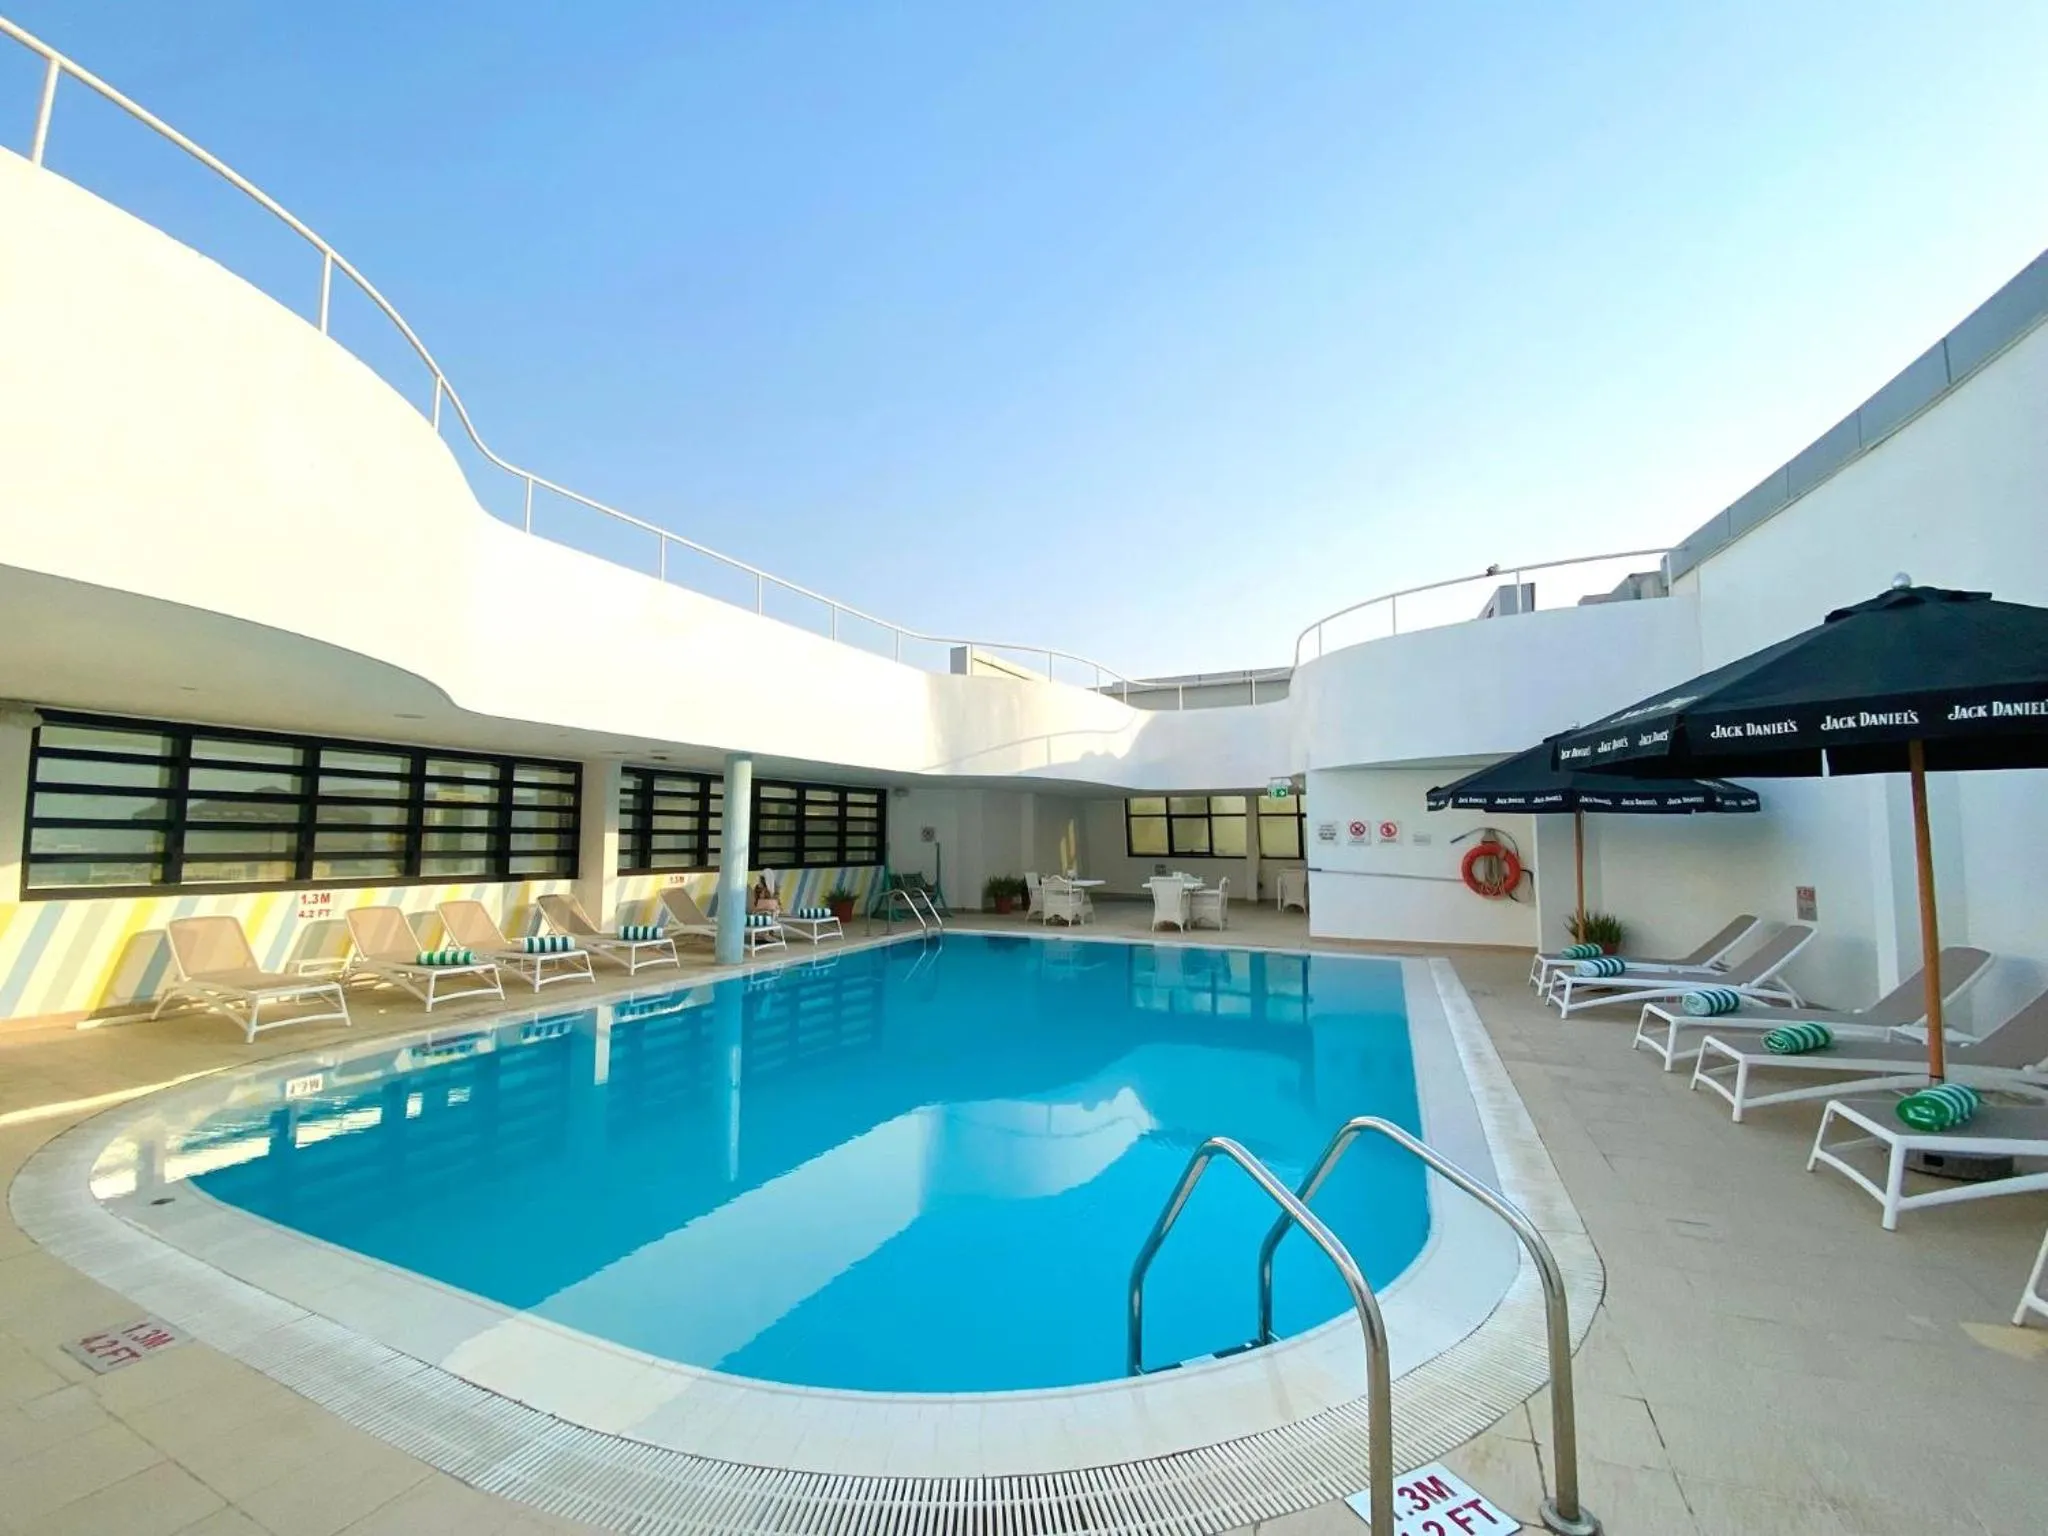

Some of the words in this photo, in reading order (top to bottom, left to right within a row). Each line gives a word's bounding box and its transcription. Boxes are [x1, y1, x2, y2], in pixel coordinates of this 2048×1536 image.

[1820, 715, 1857, 731] JACK
[1859, 709, 1920, 727] DANIEL'S
[1947, 706, 1988, 720] JACK
[1992, 699, 2048, 717] DANIEL'
[1711, 725, 1742, 739] JACK
[1746, 718, 1799, 736] DANIEL'S
[301, 893, 330, 904] 1.3M
[1394, 1475, 1458, 1521] .3M
[1446, 1498, 1499, 1536] FT
